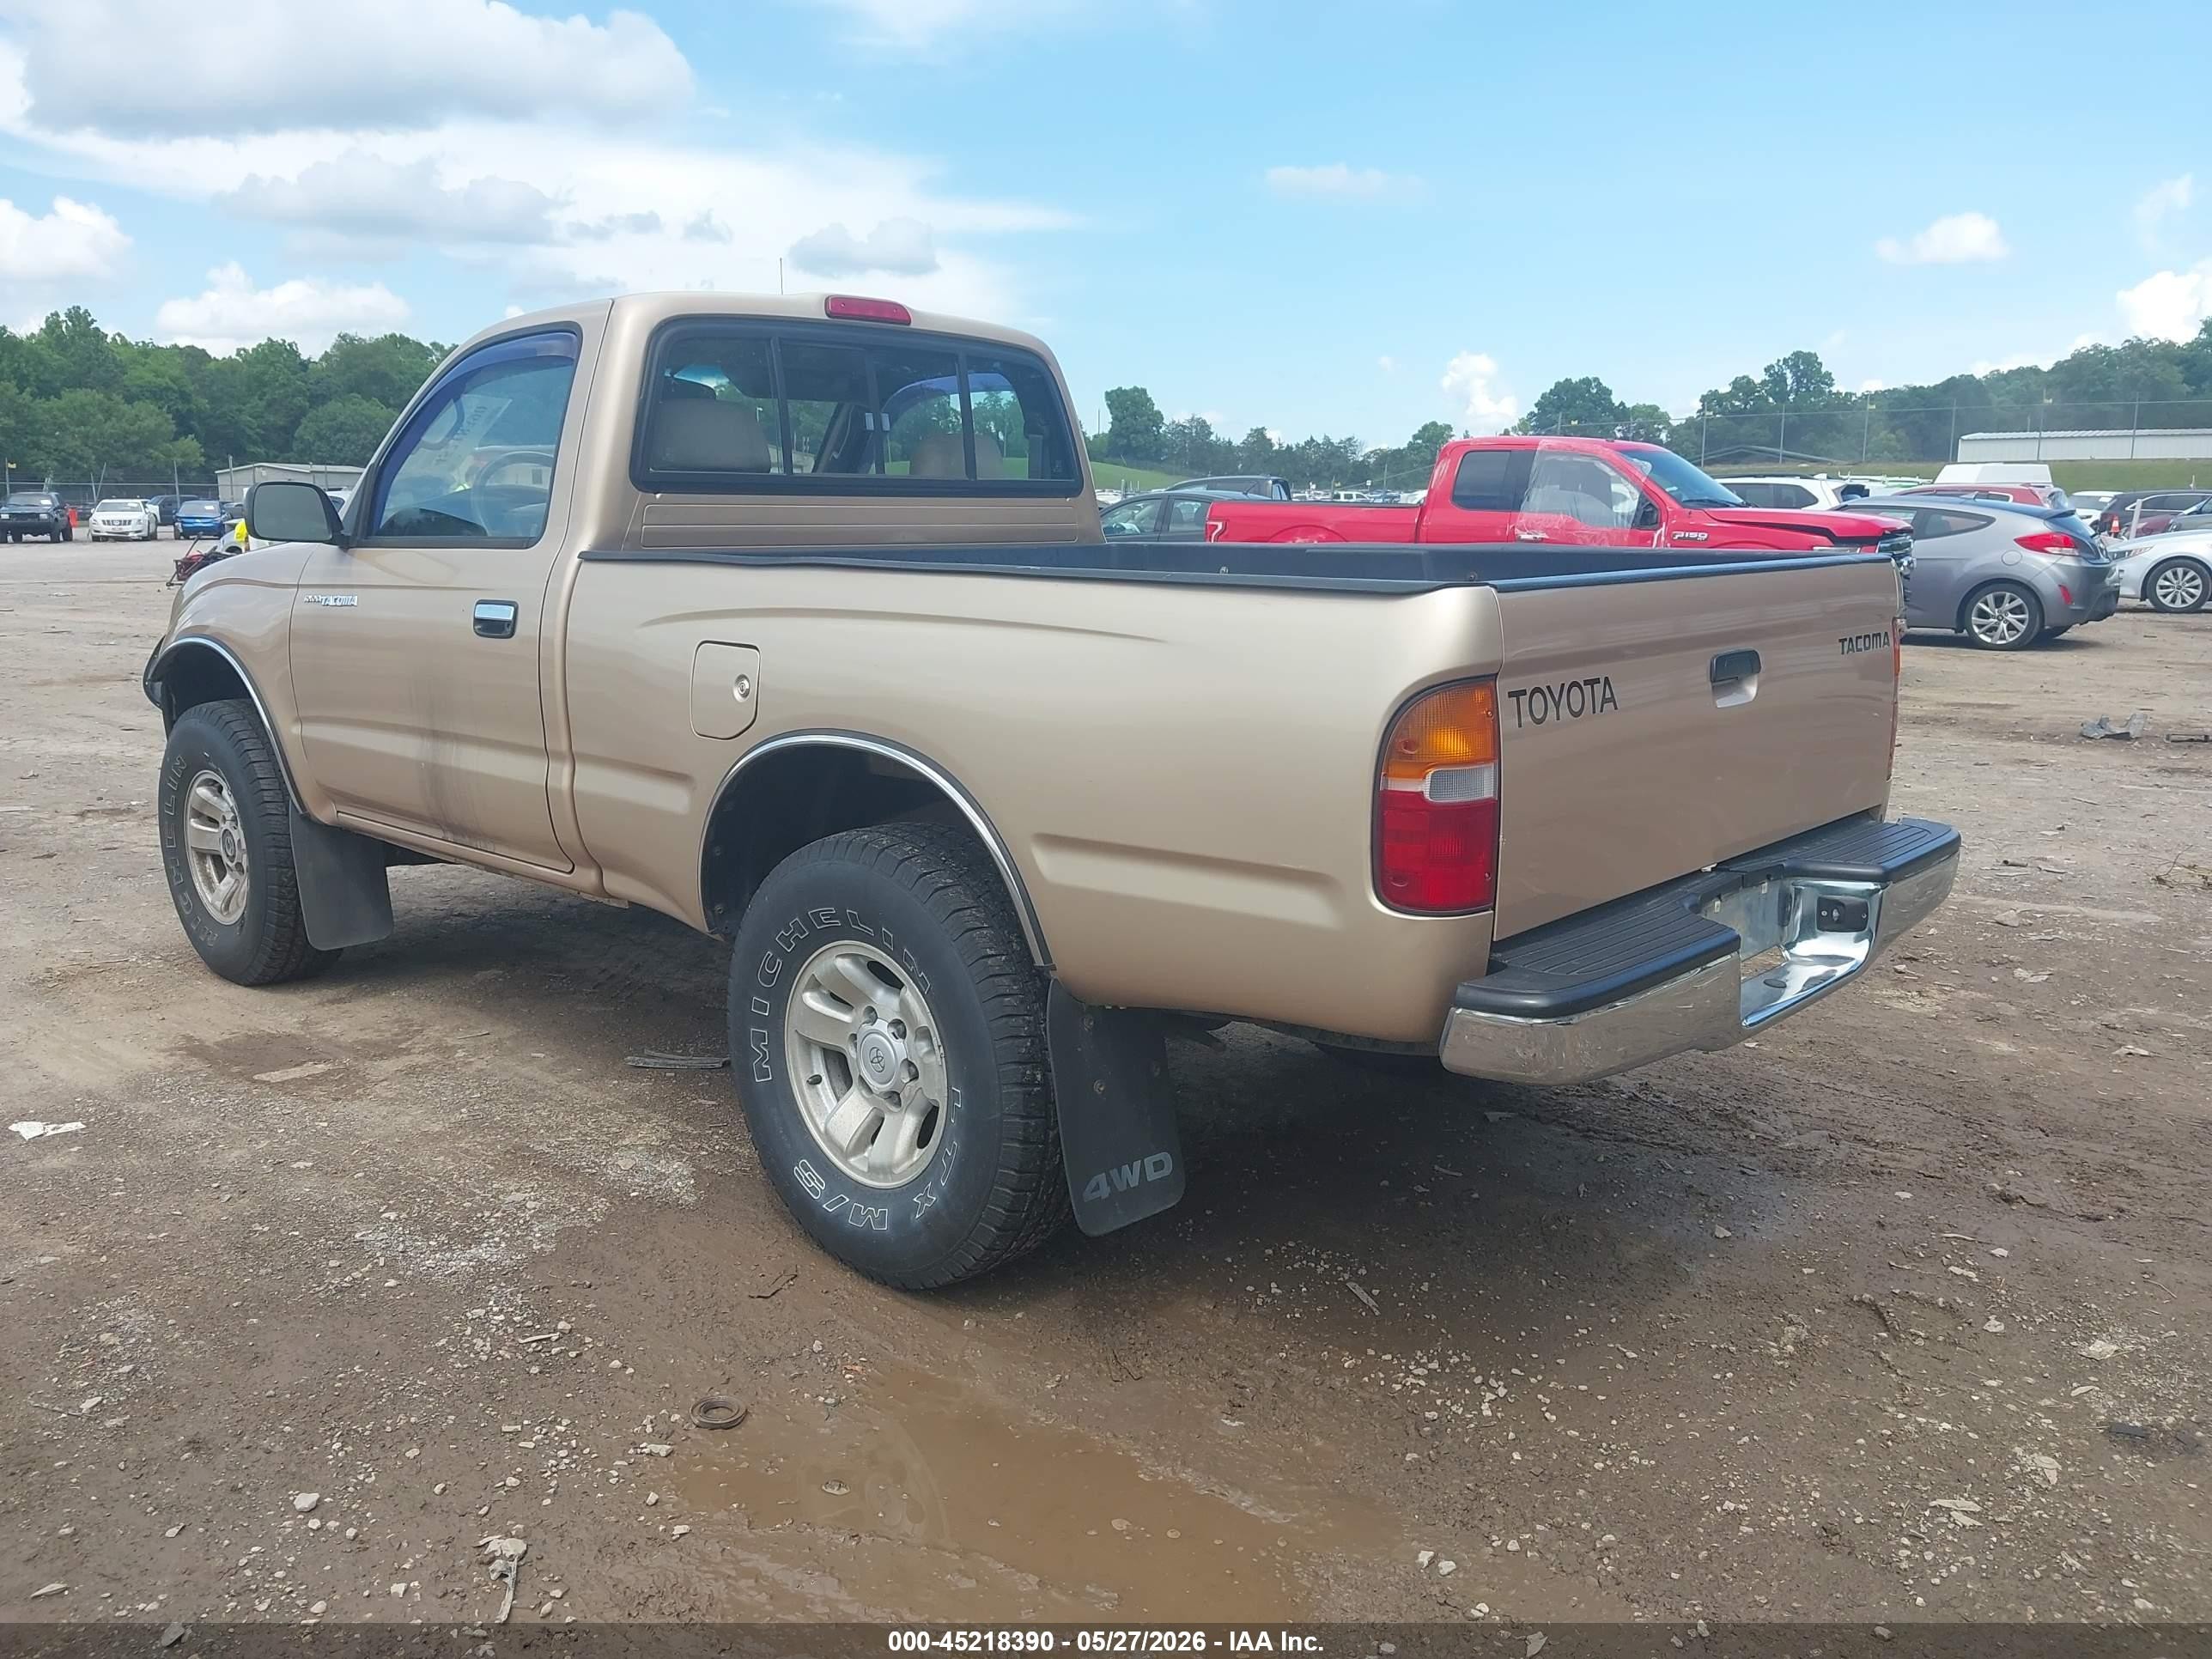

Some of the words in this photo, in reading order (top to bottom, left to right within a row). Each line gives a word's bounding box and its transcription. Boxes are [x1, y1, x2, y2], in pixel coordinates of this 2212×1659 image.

[1838, 631, 1890, 655] TACOMA
[1508, 676, 1619, 728] TOYOTA
[750, 907, 932, 1083] MICHELIN
[793, 1158, 890, 1231] M/S
[1083, 1152, 1173, 1203] 4WD
